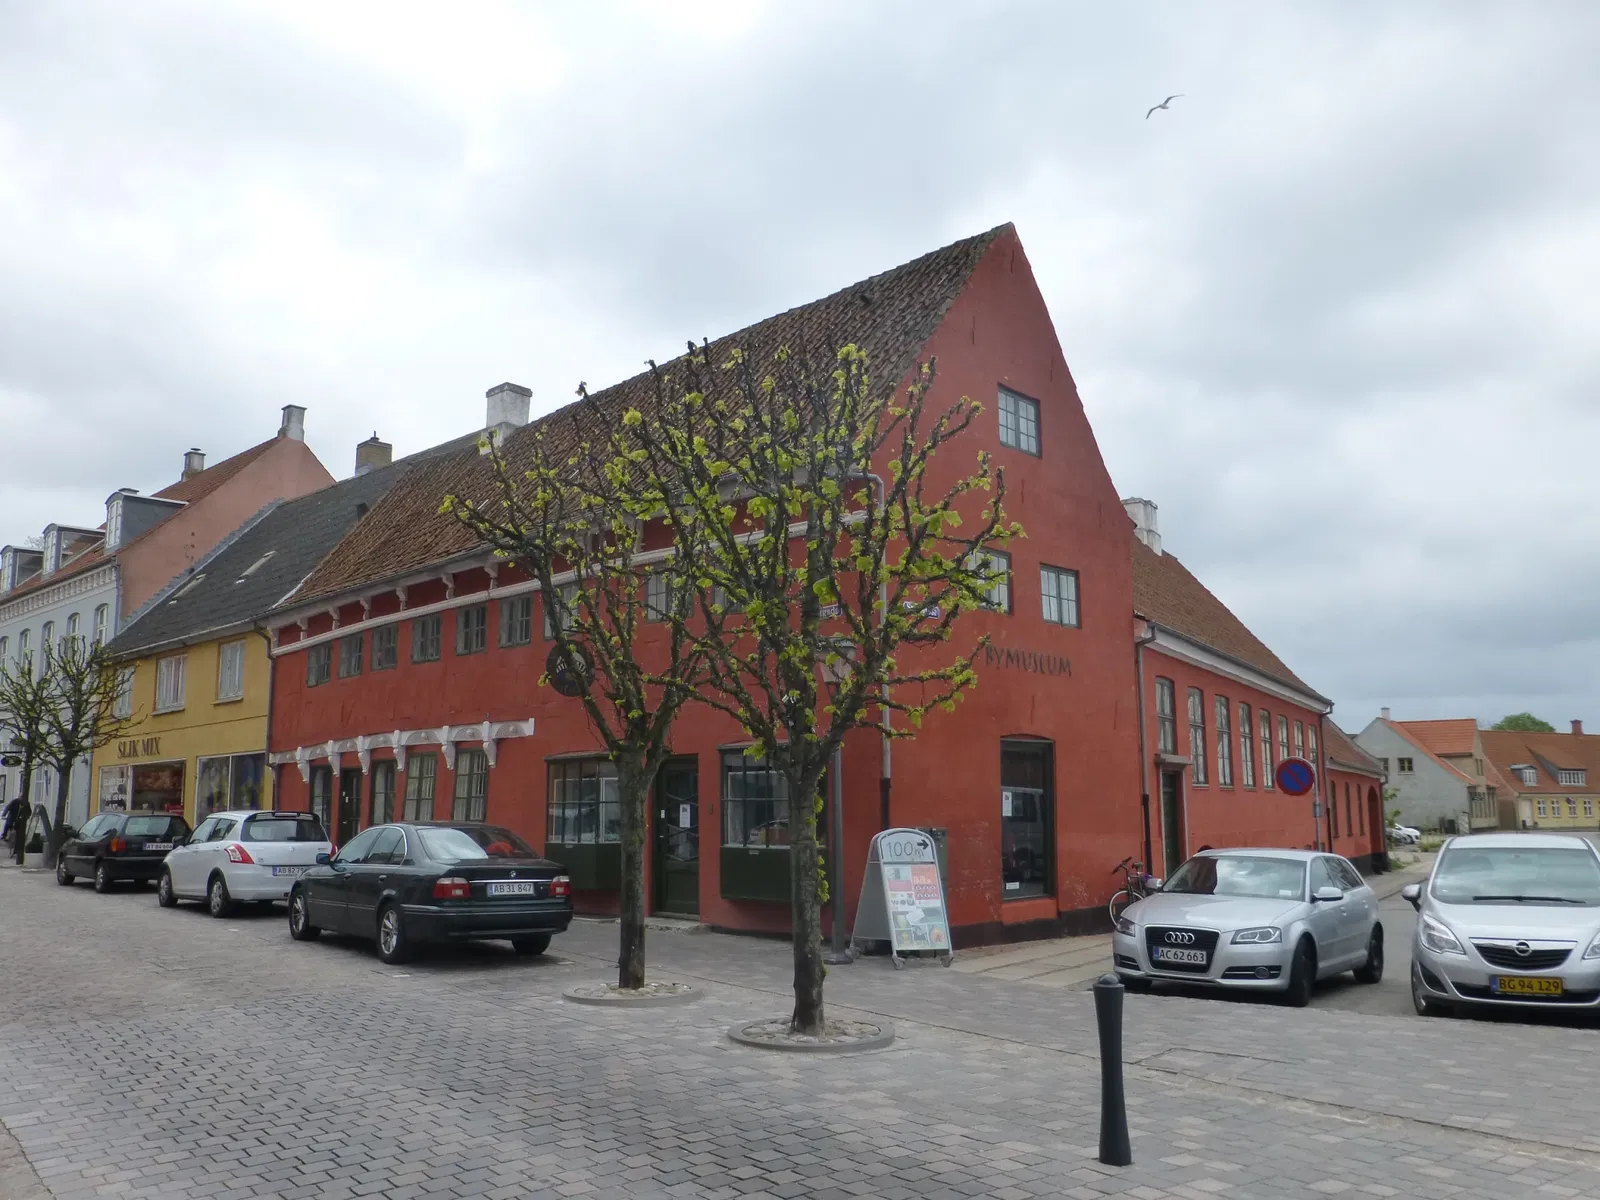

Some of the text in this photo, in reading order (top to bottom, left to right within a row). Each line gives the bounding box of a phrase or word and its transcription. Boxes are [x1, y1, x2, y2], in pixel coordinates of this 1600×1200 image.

[985, 643, 1072, 677] BYMUSEUM
[118, 737, 161, 759] SLIK MIX
[288, 867, 296, 875] 82
[494, 883, 532, 893] AB 31 847
[1160, 949, 1205, 962] AC 62 663
[1499, 978, 1560, 992] BG 94 129
